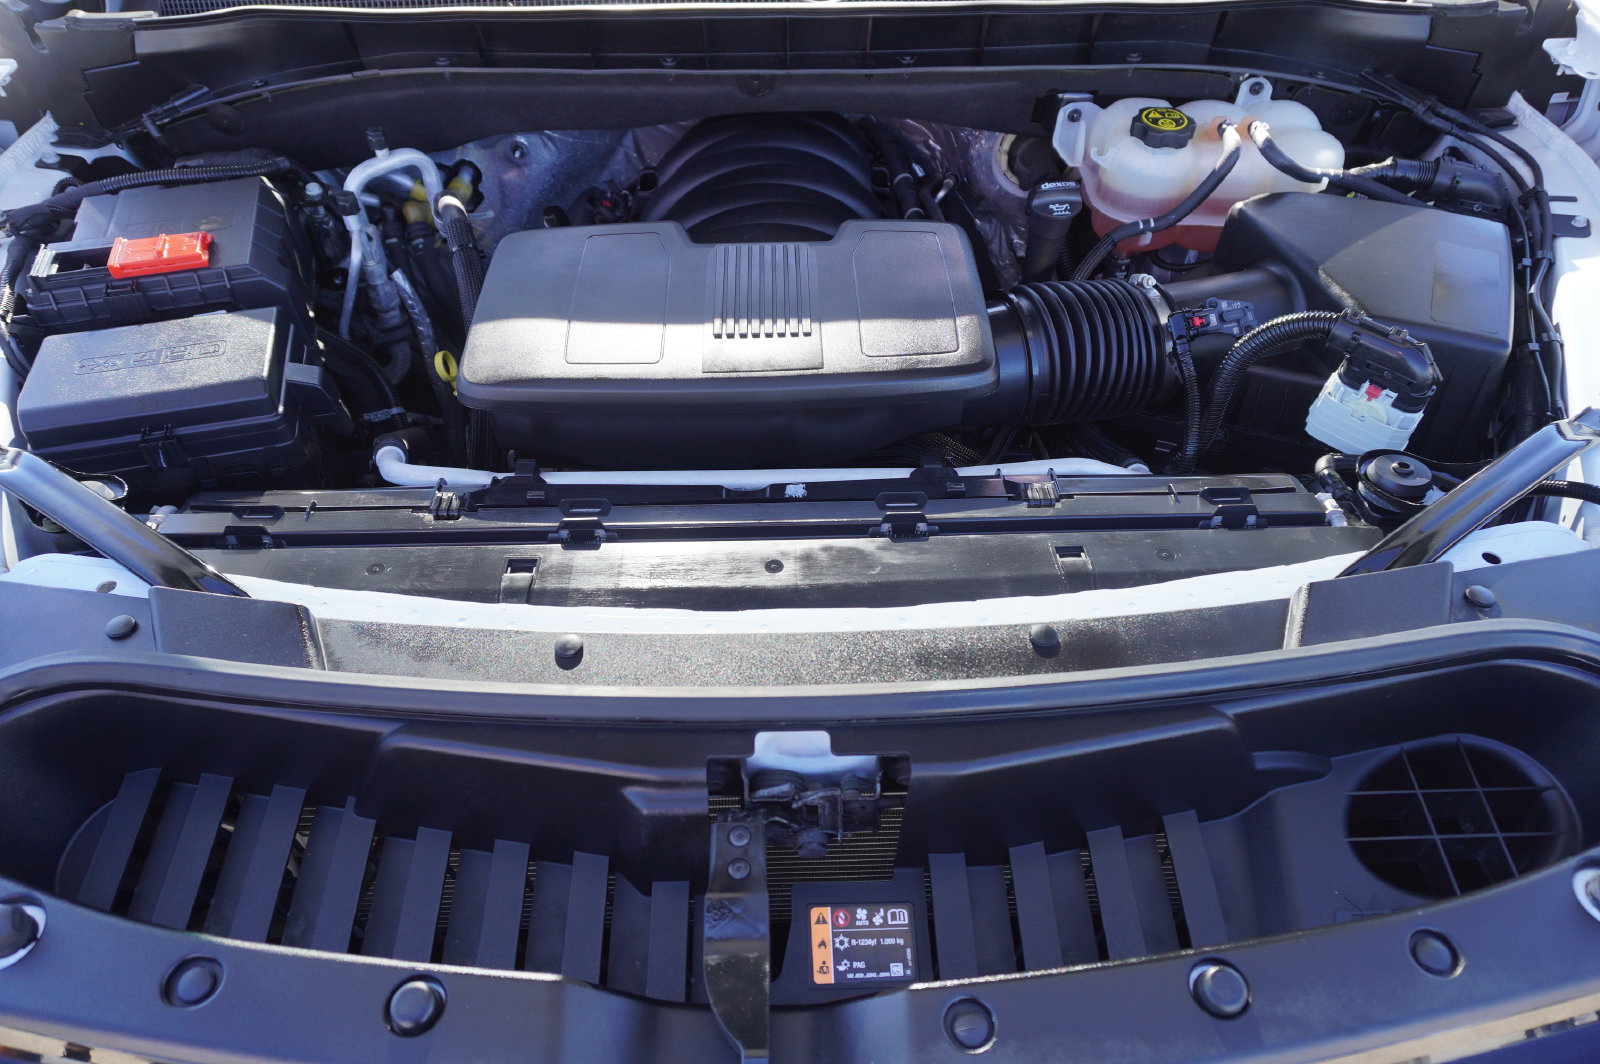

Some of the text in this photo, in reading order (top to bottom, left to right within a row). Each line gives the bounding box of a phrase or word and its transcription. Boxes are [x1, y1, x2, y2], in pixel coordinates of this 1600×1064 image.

[1041, 181, 1076, 189] dexos
[851, 938, 877, 947] R-1234yf
[853, 961, 866, 969] PAG
